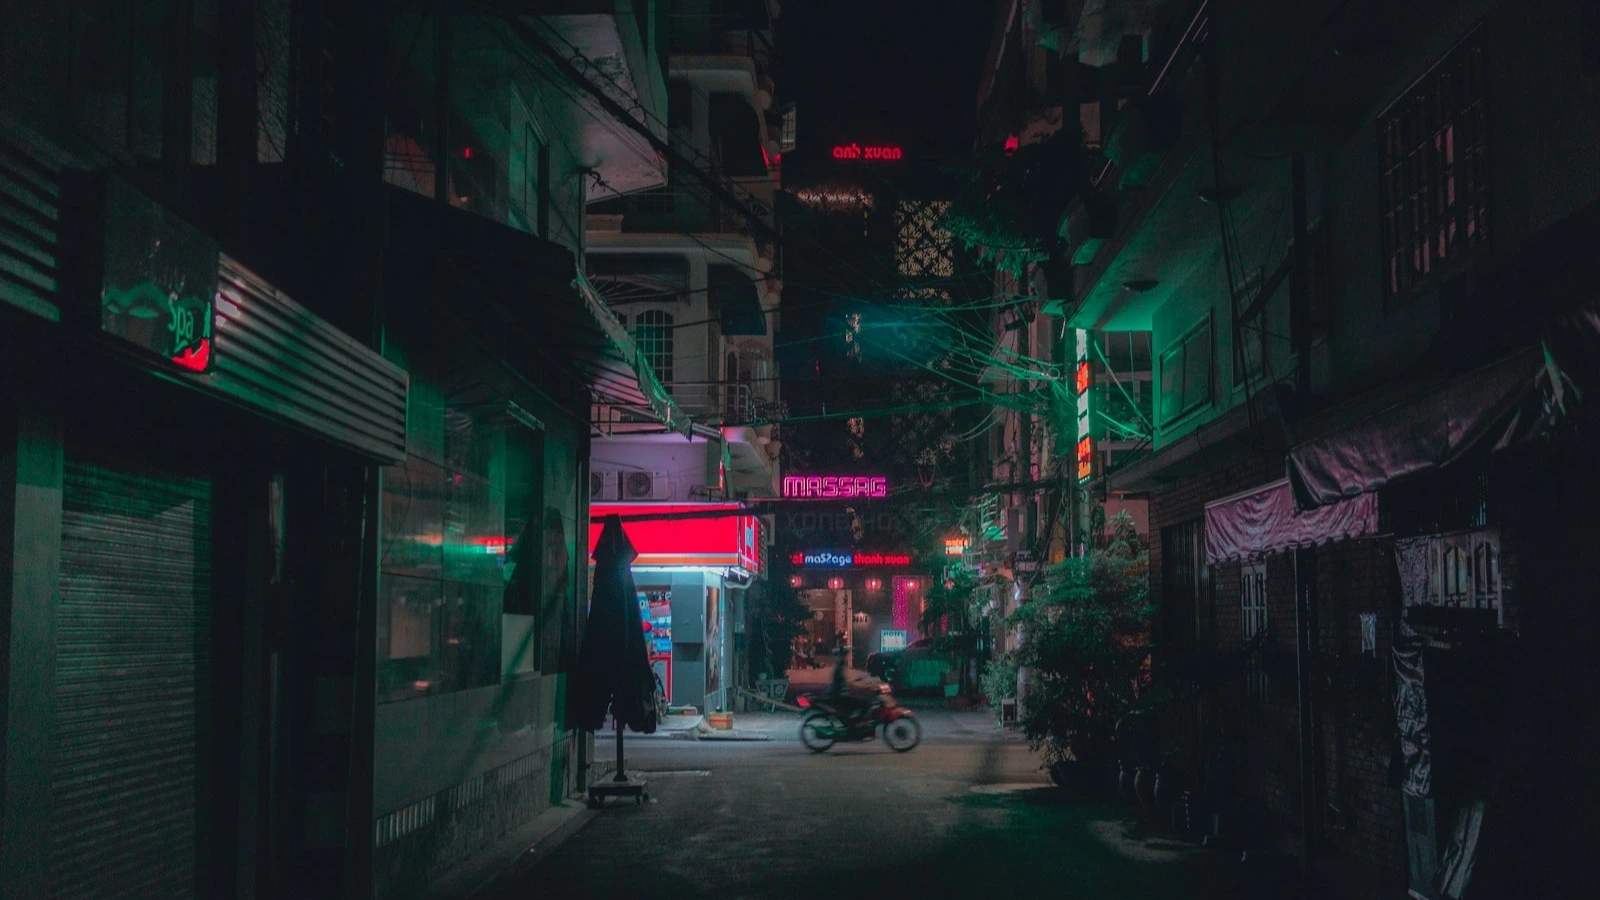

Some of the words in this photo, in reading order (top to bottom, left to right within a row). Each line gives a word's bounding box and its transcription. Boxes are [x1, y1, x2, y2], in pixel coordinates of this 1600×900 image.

[864, 147, 902, 160] xuan
[167, 296, 194, 344] Spa
[783, 476, 887, 498] MASSAG
[853, 553, 884, 566] thanh
[885, 555, 910, 566] xuan
